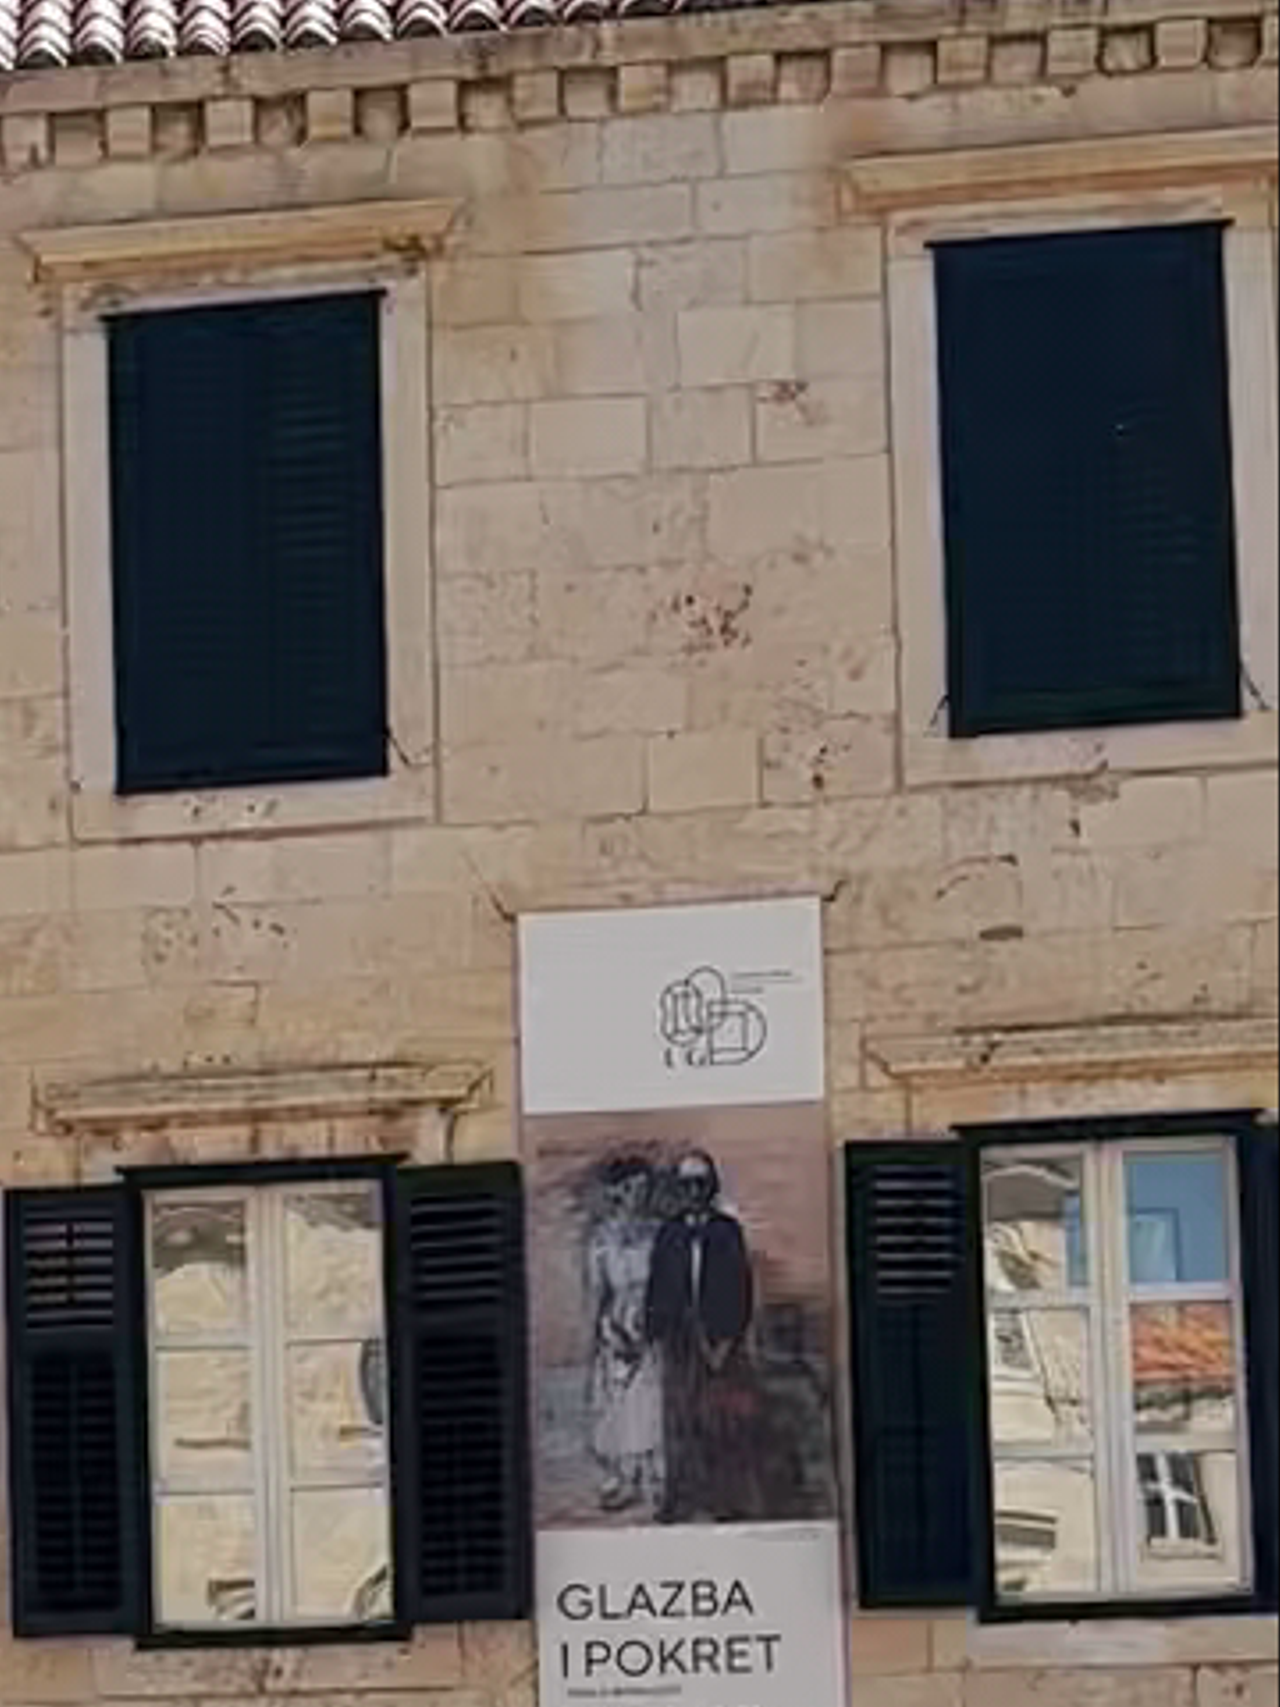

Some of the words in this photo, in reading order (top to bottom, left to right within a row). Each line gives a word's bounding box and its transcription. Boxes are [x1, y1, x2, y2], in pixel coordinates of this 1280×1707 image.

[556, 1581, 755, 1621] GLAZBA
[560, 1643, 570, 1678] I
[584, 1634, 782, 1678] POKRET
